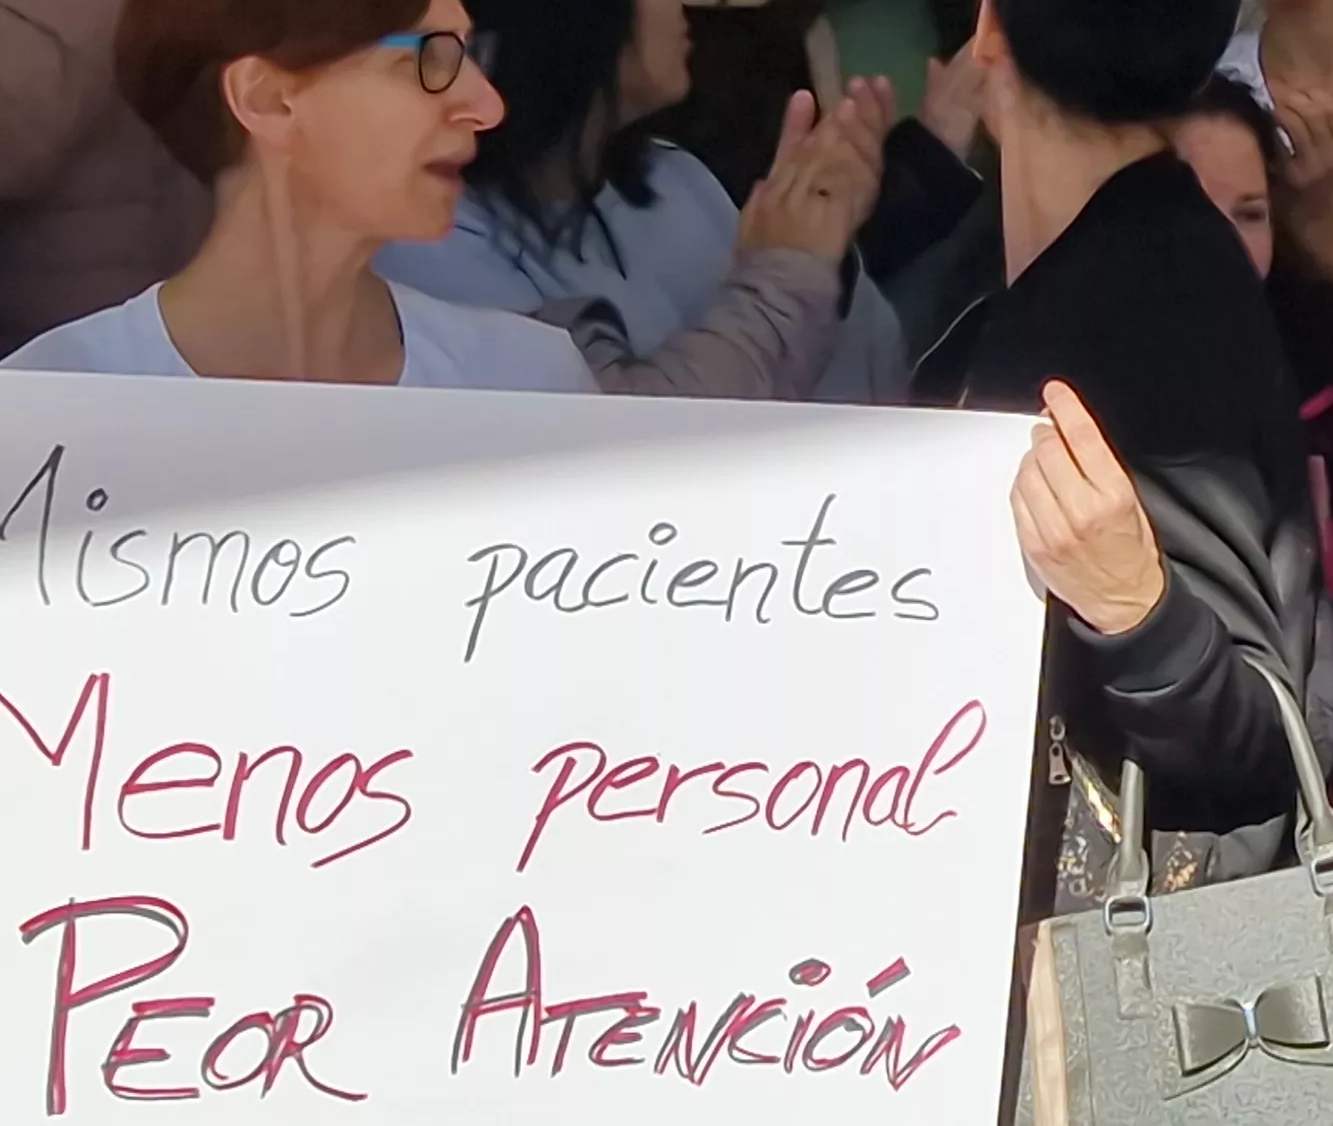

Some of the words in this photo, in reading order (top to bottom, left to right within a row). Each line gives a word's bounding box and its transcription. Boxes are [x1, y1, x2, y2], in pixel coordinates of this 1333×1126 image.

[463, 492, 941, 664] pacientes
[0, 671, 416, 870] Menos
[515, 698, 988, 874] personal
